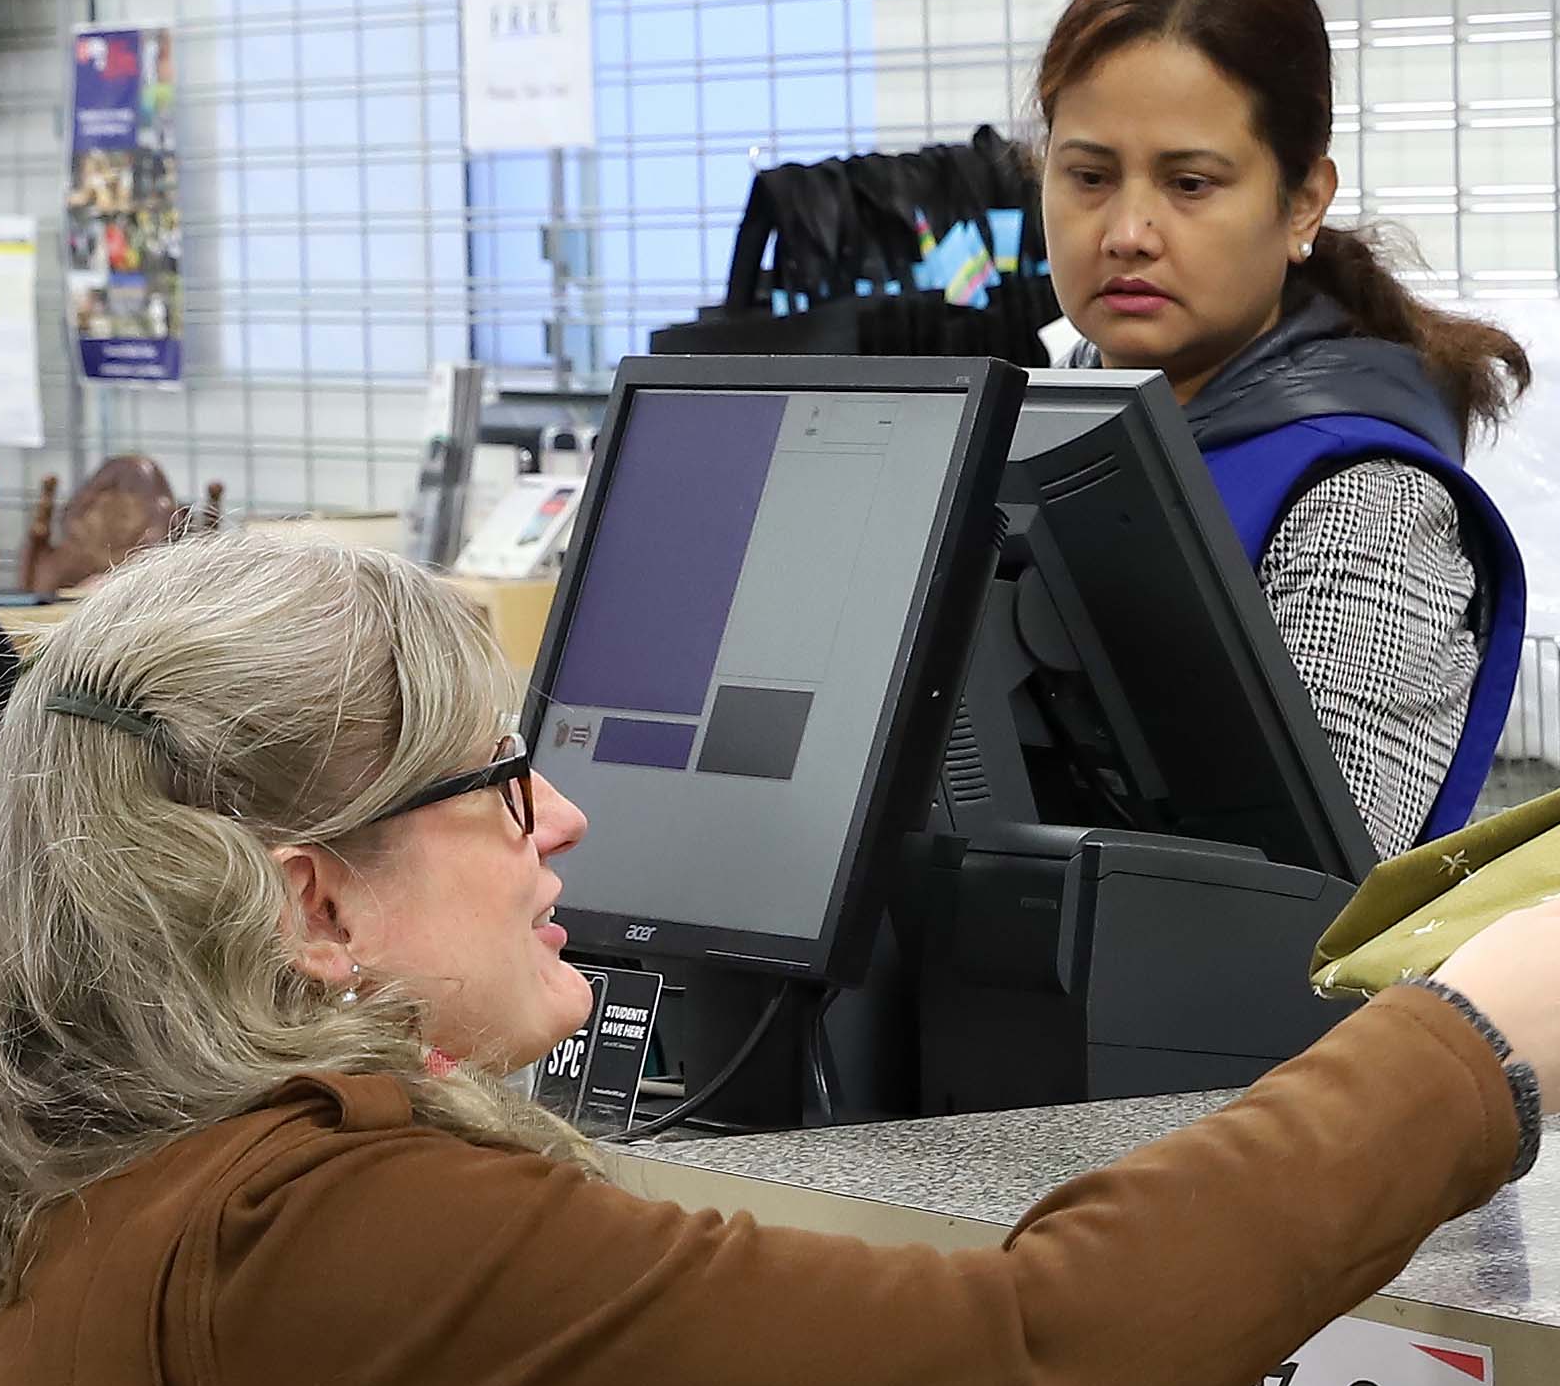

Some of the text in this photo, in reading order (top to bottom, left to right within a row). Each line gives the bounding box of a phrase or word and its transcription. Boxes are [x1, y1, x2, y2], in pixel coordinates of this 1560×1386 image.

[624, 921, 658, 942] acer
[604, 1004, 649, 1024] STUDENTS
[600, 1020, 646, 1041] SAVE HERE
[547, 1038, 586, 1079] SPC
